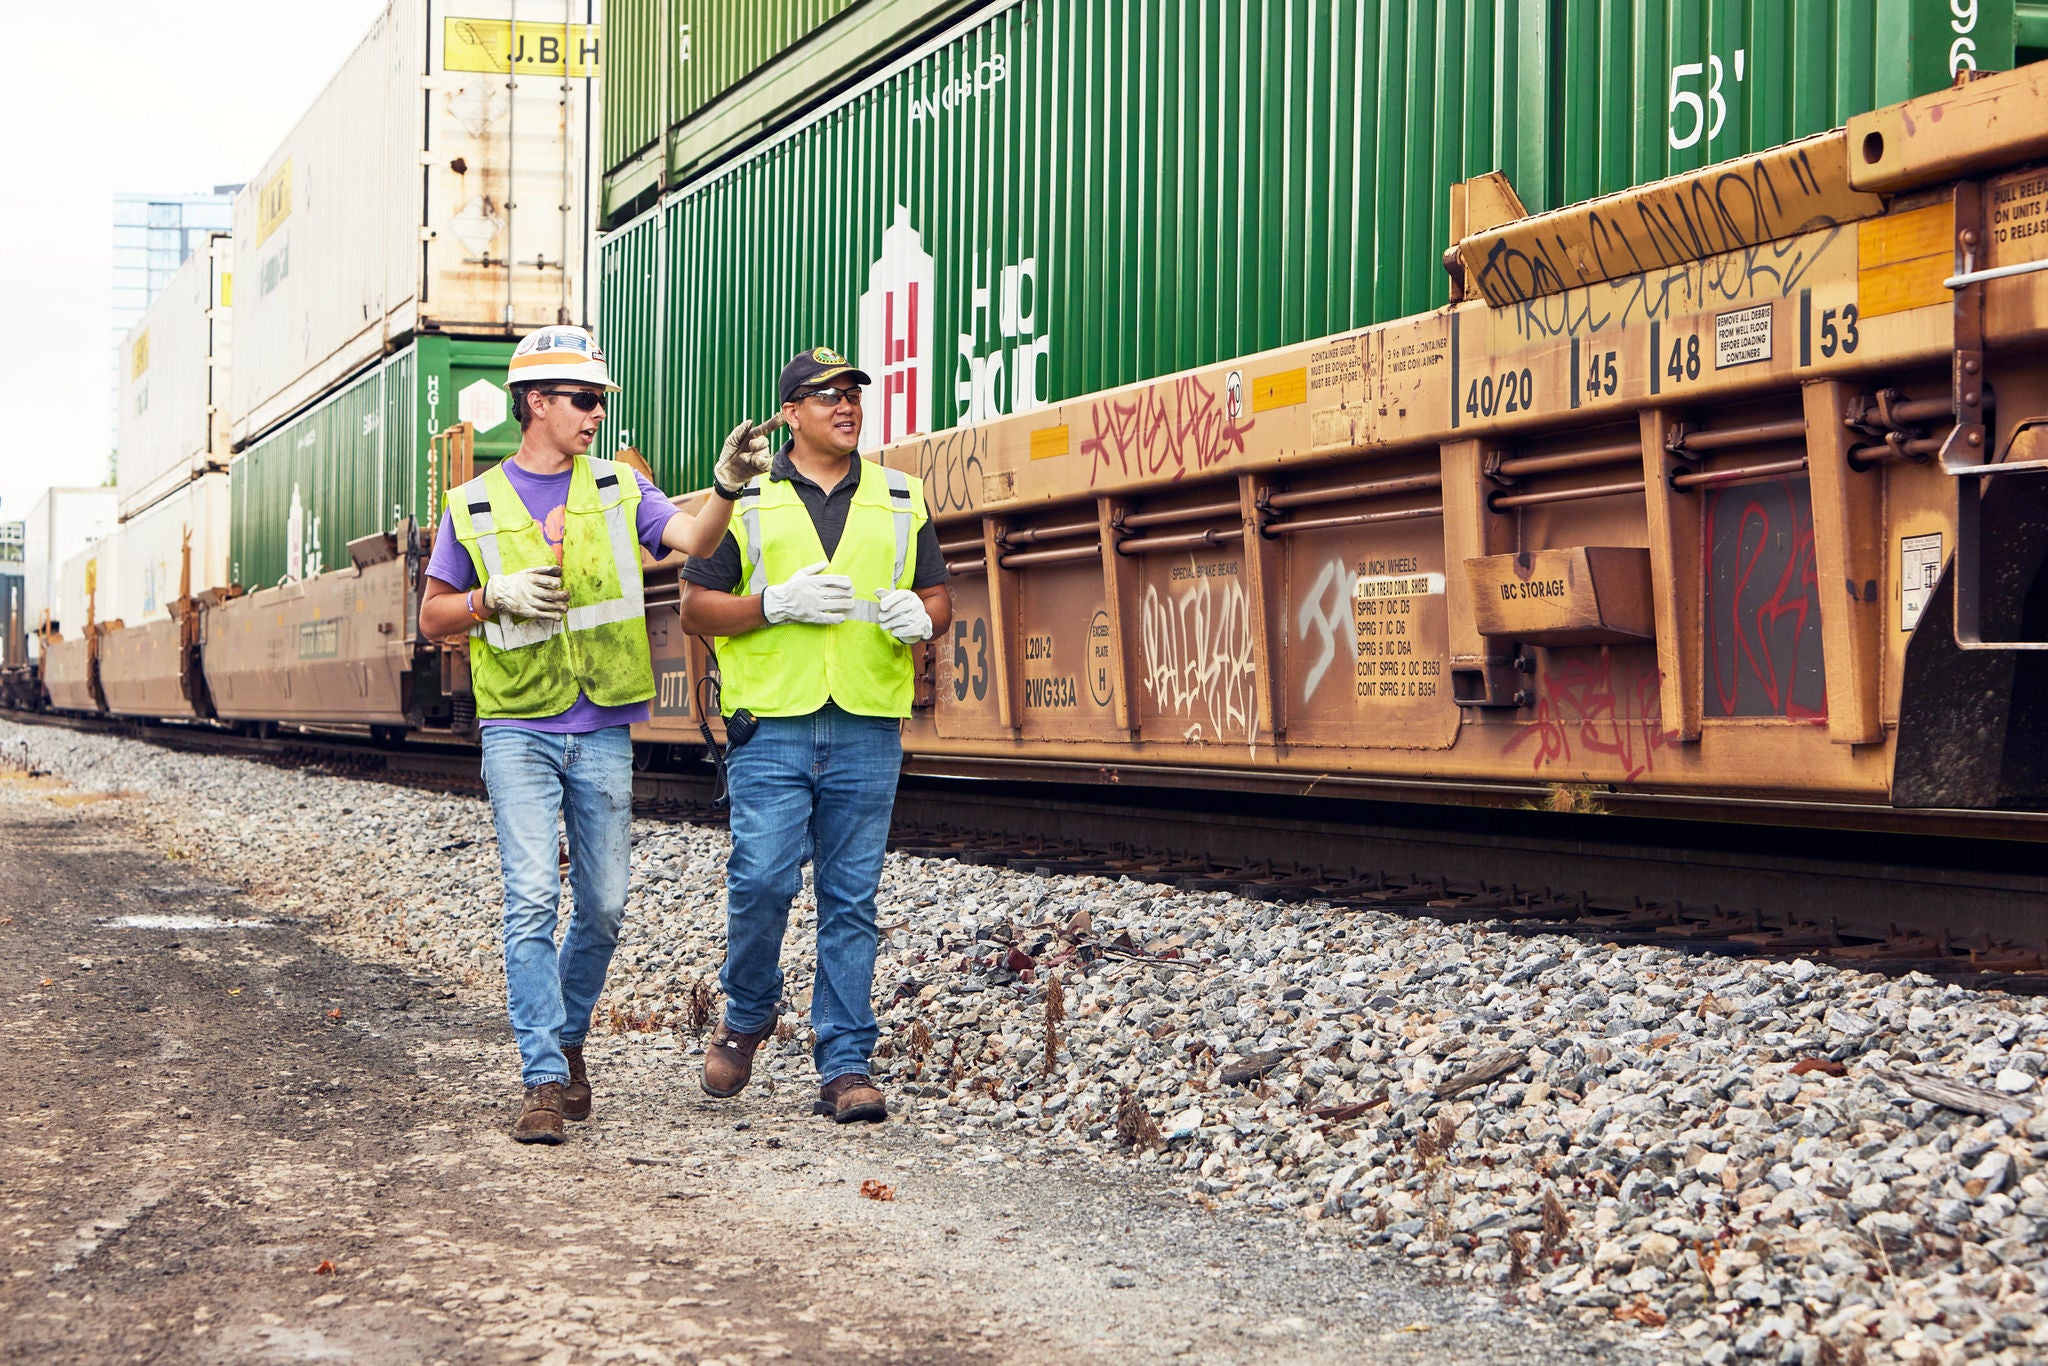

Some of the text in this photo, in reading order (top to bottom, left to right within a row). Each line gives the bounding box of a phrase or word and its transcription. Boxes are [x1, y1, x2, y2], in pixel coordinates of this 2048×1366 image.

[1994, 187, 2017, 205] PULL
[1994, 208, 2009, 224] ON
[2013, 201, 2040, 220] UNITS
[1994, 229, 2007, 244] TO
[1717, 308, 1771, 327] REMOVE ALL DEBRIS
[1718, 321, 1769, 339] FROM WELL FLOOR
[1820, 303, 1859, 358] 53
[1401, 345, 1415, 357] WIDE
[1720, 335, 1766, 351] BEFORE LOADING
[1311, 347, 1340, 363] CONTAINER
[1667, 334, 1700, 382] 48
[1726, 348, 1761, 363] CONTAINERS
[1311, 364, 1324, 376] MUST
[1325, 363, 1331, 373] BE
[1393, 361, 1406, 373] WIDE
[1586, 351, 1618, 397] 45
[1311, 378, 1324, 390] MUST
[1325, 376, 1331, 387] BE
[1332, 375, 1339, 386] UP
[1466, 367, 1533, 418] 40/20
[1172, 562, 1238, 581] SPECIAL BRAKE BEAMS
[1368, 560, 1385, 575] INCH
[1388, 557, 1417, 573] WHEELS
[1363, 582, 1375, 597] INCH
[1376, 581, 1393, 596] TREAD
[1411, 578, 1428, 593] SHOES
[1500, 580, 1565, 600] IBC STORAGE
[1357, 600, 1410, 616] SPRG 7 OC D5
[1357, 620, 1405, 636] SPRG 7 IC D6
[1095, 645, 1109, 658] PLATE
[1357, 642, 1376, 656] SPRG
[1397, 641, 1412, 655] D6A
[953, 617, 989, 702] 53
[1357, 661, 1440, 676] CONT SPRG 2 OC B353
[1098, 668, 1106, 691] H
[1025, 677, 1077, 707] RWG33A
[1357, 682, 1436, 696] CONT SPRG 2 IC B354
